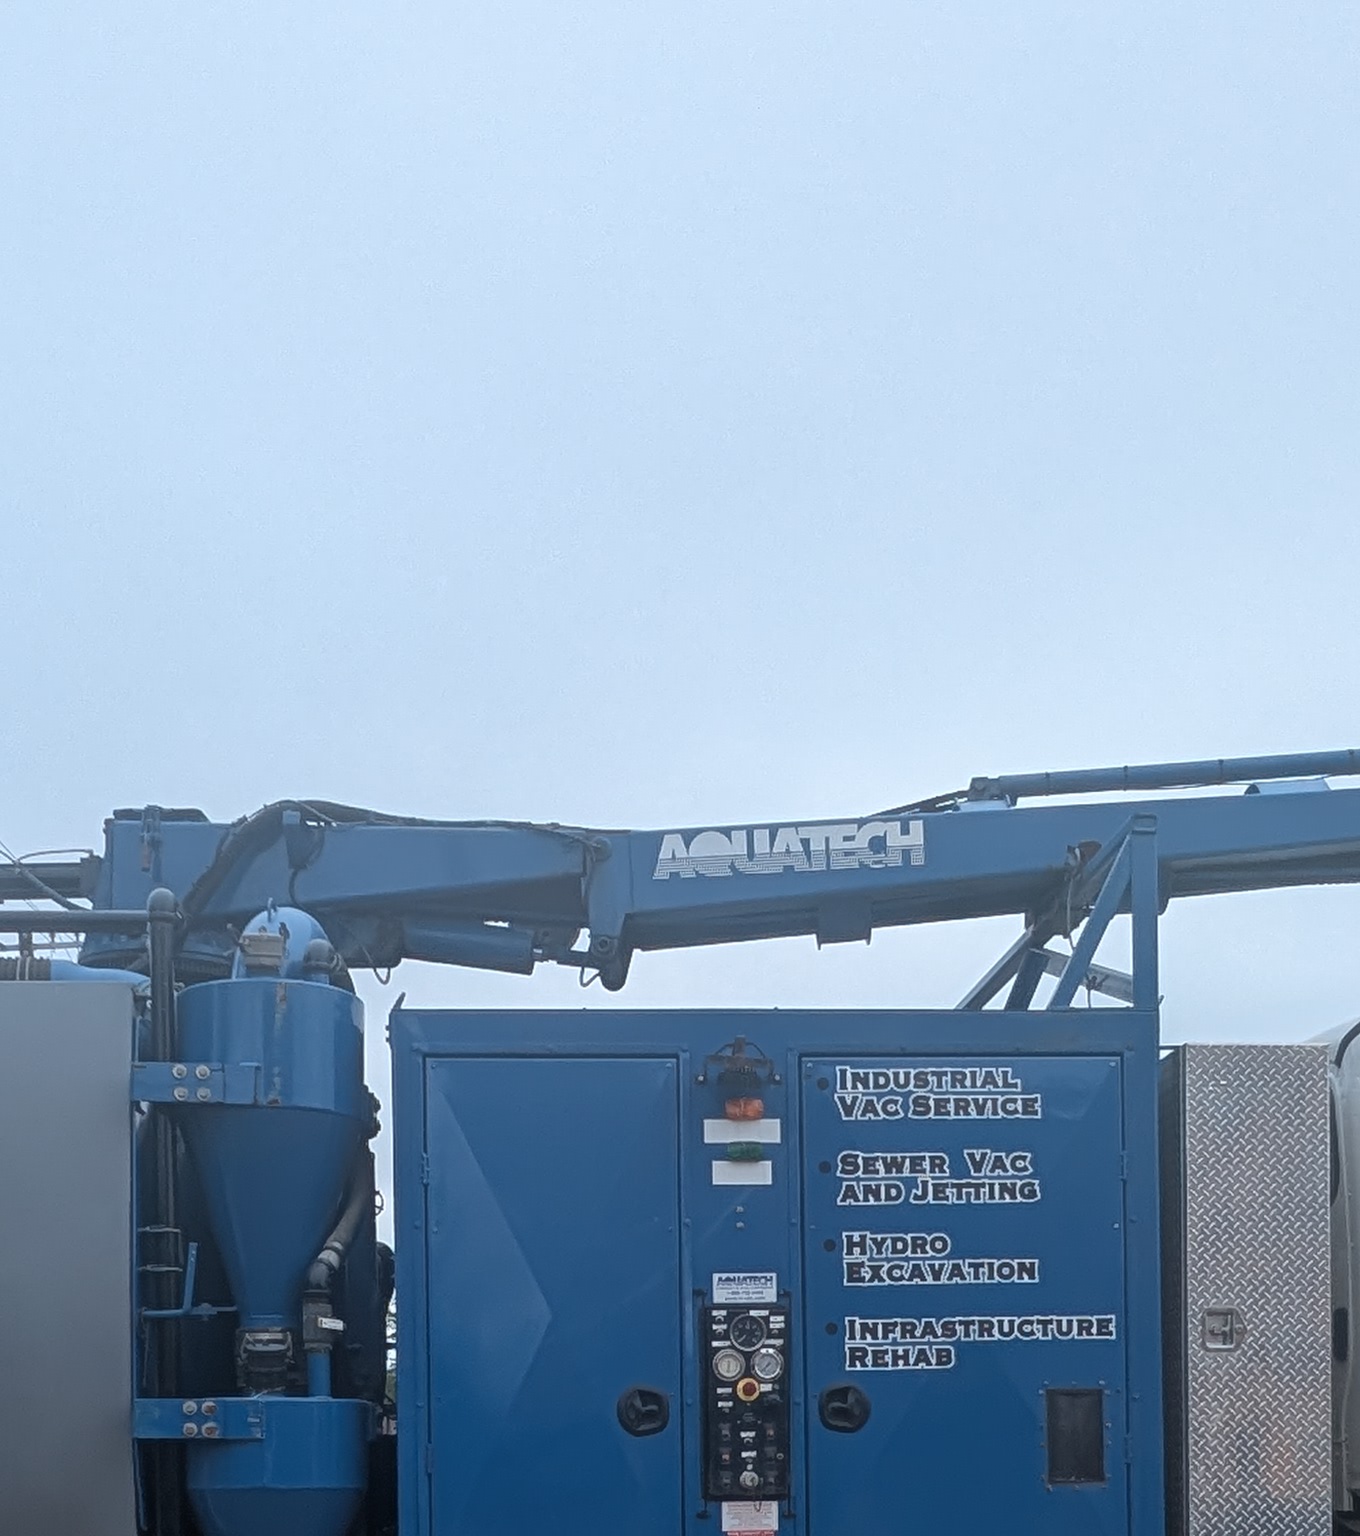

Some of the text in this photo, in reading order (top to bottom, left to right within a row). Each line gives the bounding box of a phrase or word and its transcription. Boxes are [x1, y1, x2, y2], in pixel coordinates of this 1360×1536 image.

[653, 819, 926, 880] AQUATECH
[836, 1066, 1021, 1092] INDUSTRIAL
[836, 1091, 1041, 1121] VAC SERVICE
[837, 1149, 1033, 1178] SEWER VAC
[837, 1178, 1040, 1206] AND JETTING
[843, 1232, 951, 1260] HYDRO
[844, 1259, 1039, 1286] EXCAVATION
[845, 1315, 1116, 1343] INFRASTRUCTURE
[845, 1345, 955, 1370] REHAB
